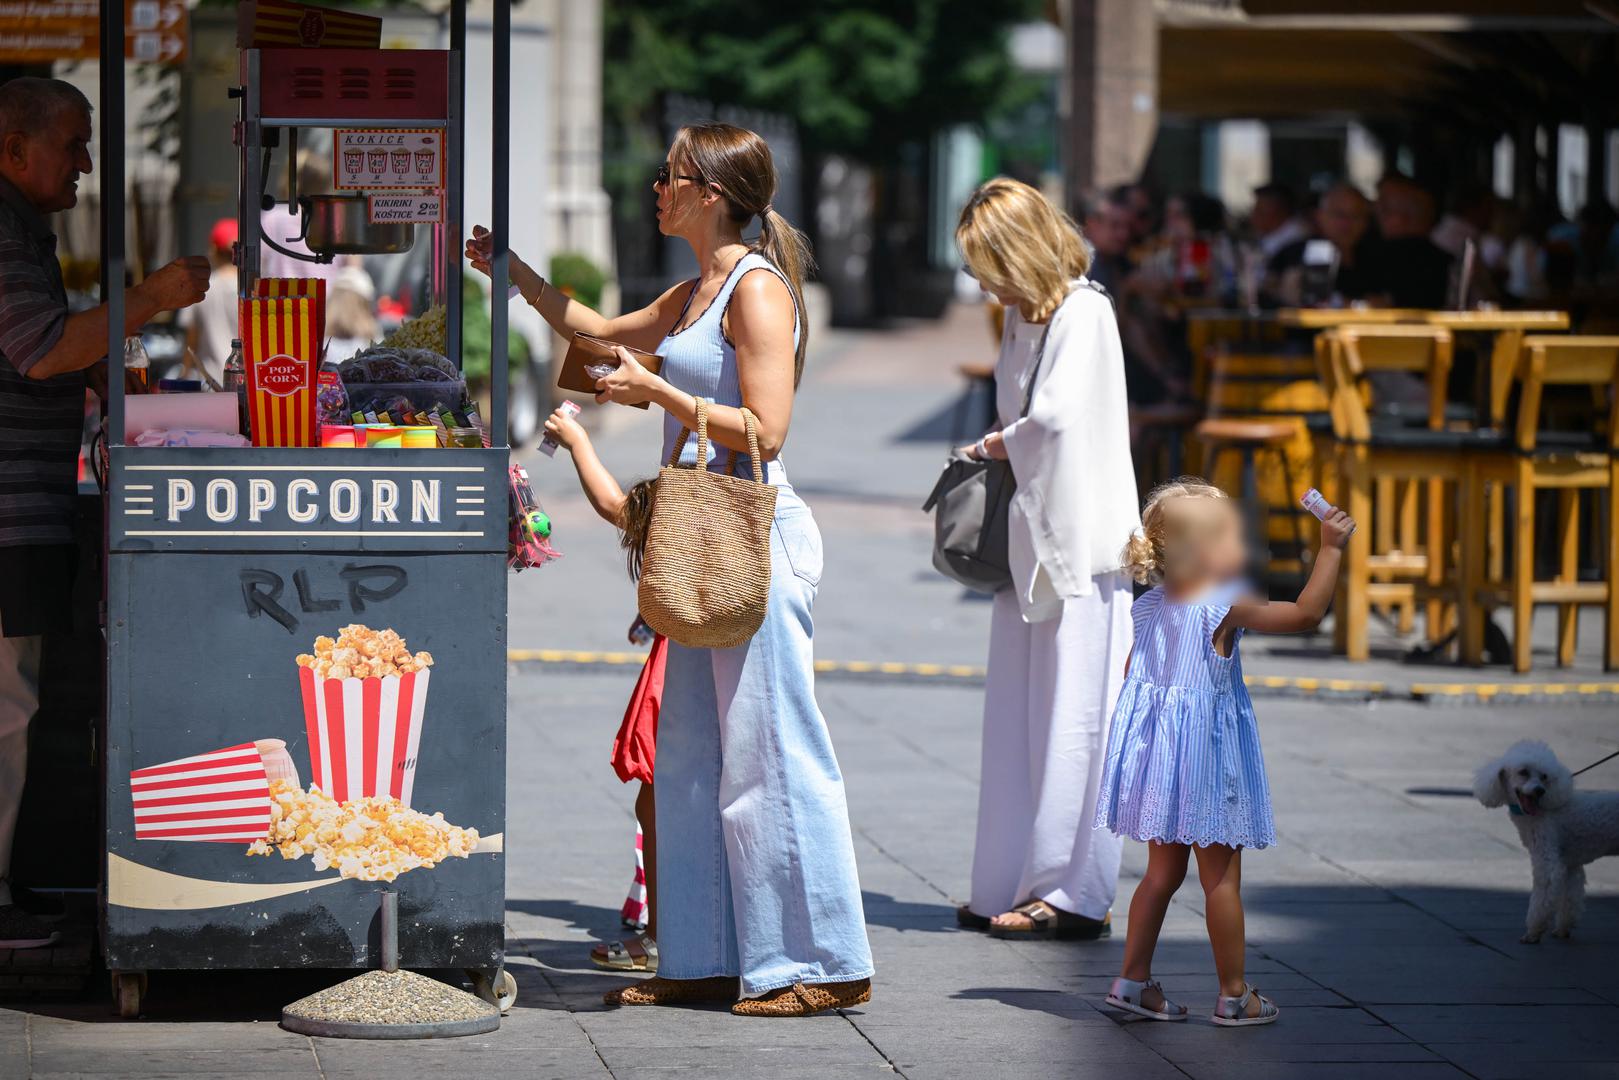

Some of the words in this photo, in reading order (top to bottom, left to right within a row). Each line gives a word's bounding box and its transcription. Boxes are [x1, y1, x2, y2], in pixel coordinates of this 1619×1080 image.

[345, 135, 405, 144] KOKICE
[374, 199, 413, 207] KIKIRIKI
[269, 366, 295, 374] POP
[264, 374, 300, 383] CORN
[167, 478, 442, 523] POPCORN
[238, 563, 409, 634] RLP
